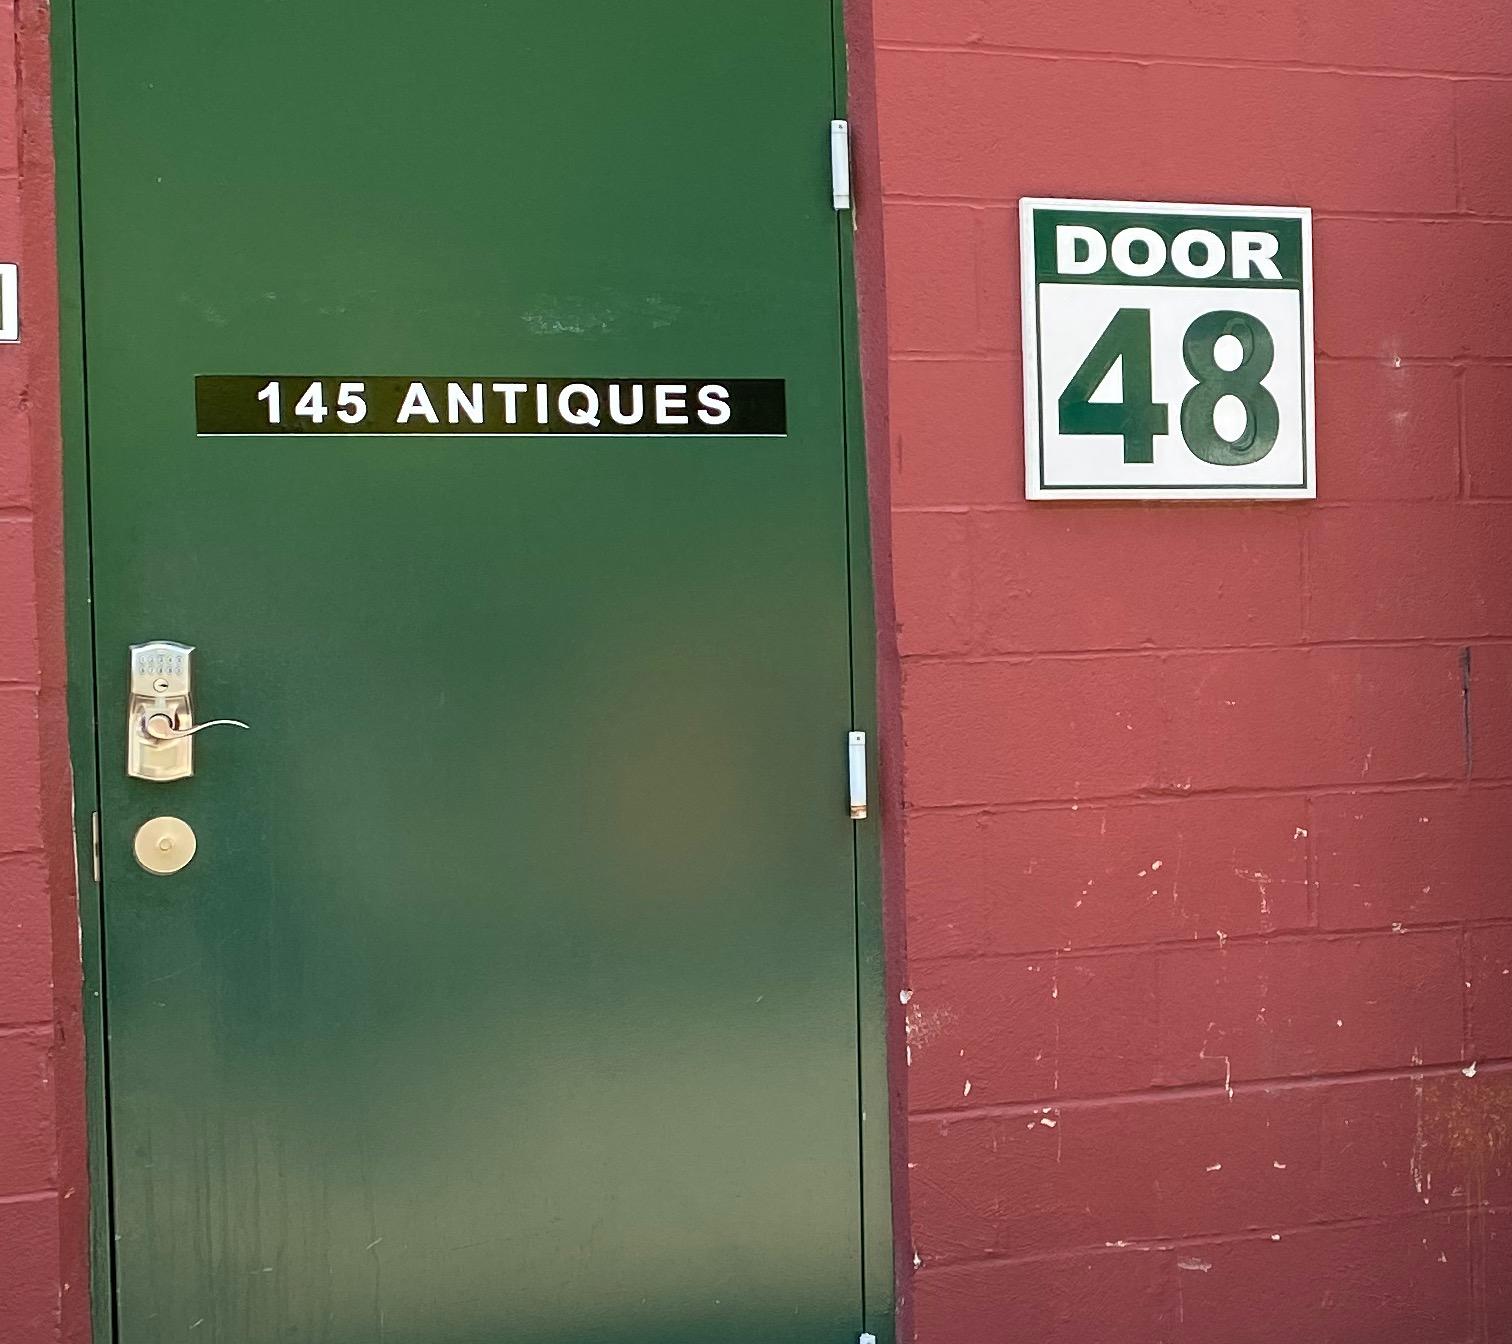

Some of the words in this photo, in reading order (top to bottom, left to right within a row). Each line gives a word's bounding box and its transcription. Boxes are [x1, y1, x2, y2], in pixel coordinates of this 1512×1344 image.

[1056, 225, 1283, 279] DOOR
[258, 382, 366, 423] 145
[397, 383, 730, 427] ANTIQUES
[1058, 308, 1279, 466] 48
